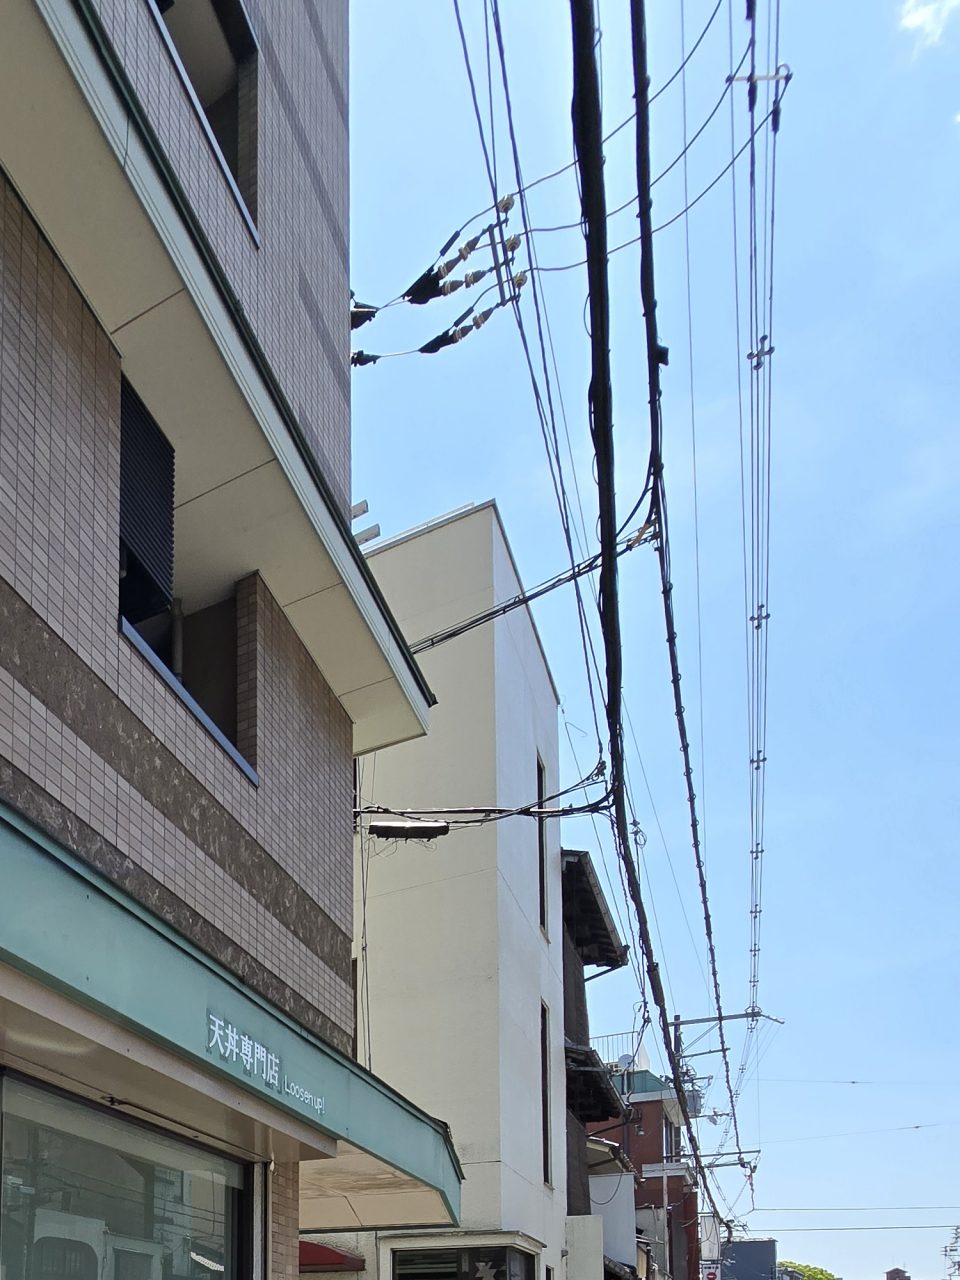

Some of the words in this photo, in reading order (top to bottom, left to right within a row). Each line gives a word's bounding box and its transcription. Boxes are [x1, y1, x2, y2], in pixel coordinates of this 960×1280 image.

[209, 1014, 280, 1087] 天丼専門店
[284, 1075, 313, 1104] Loosen
